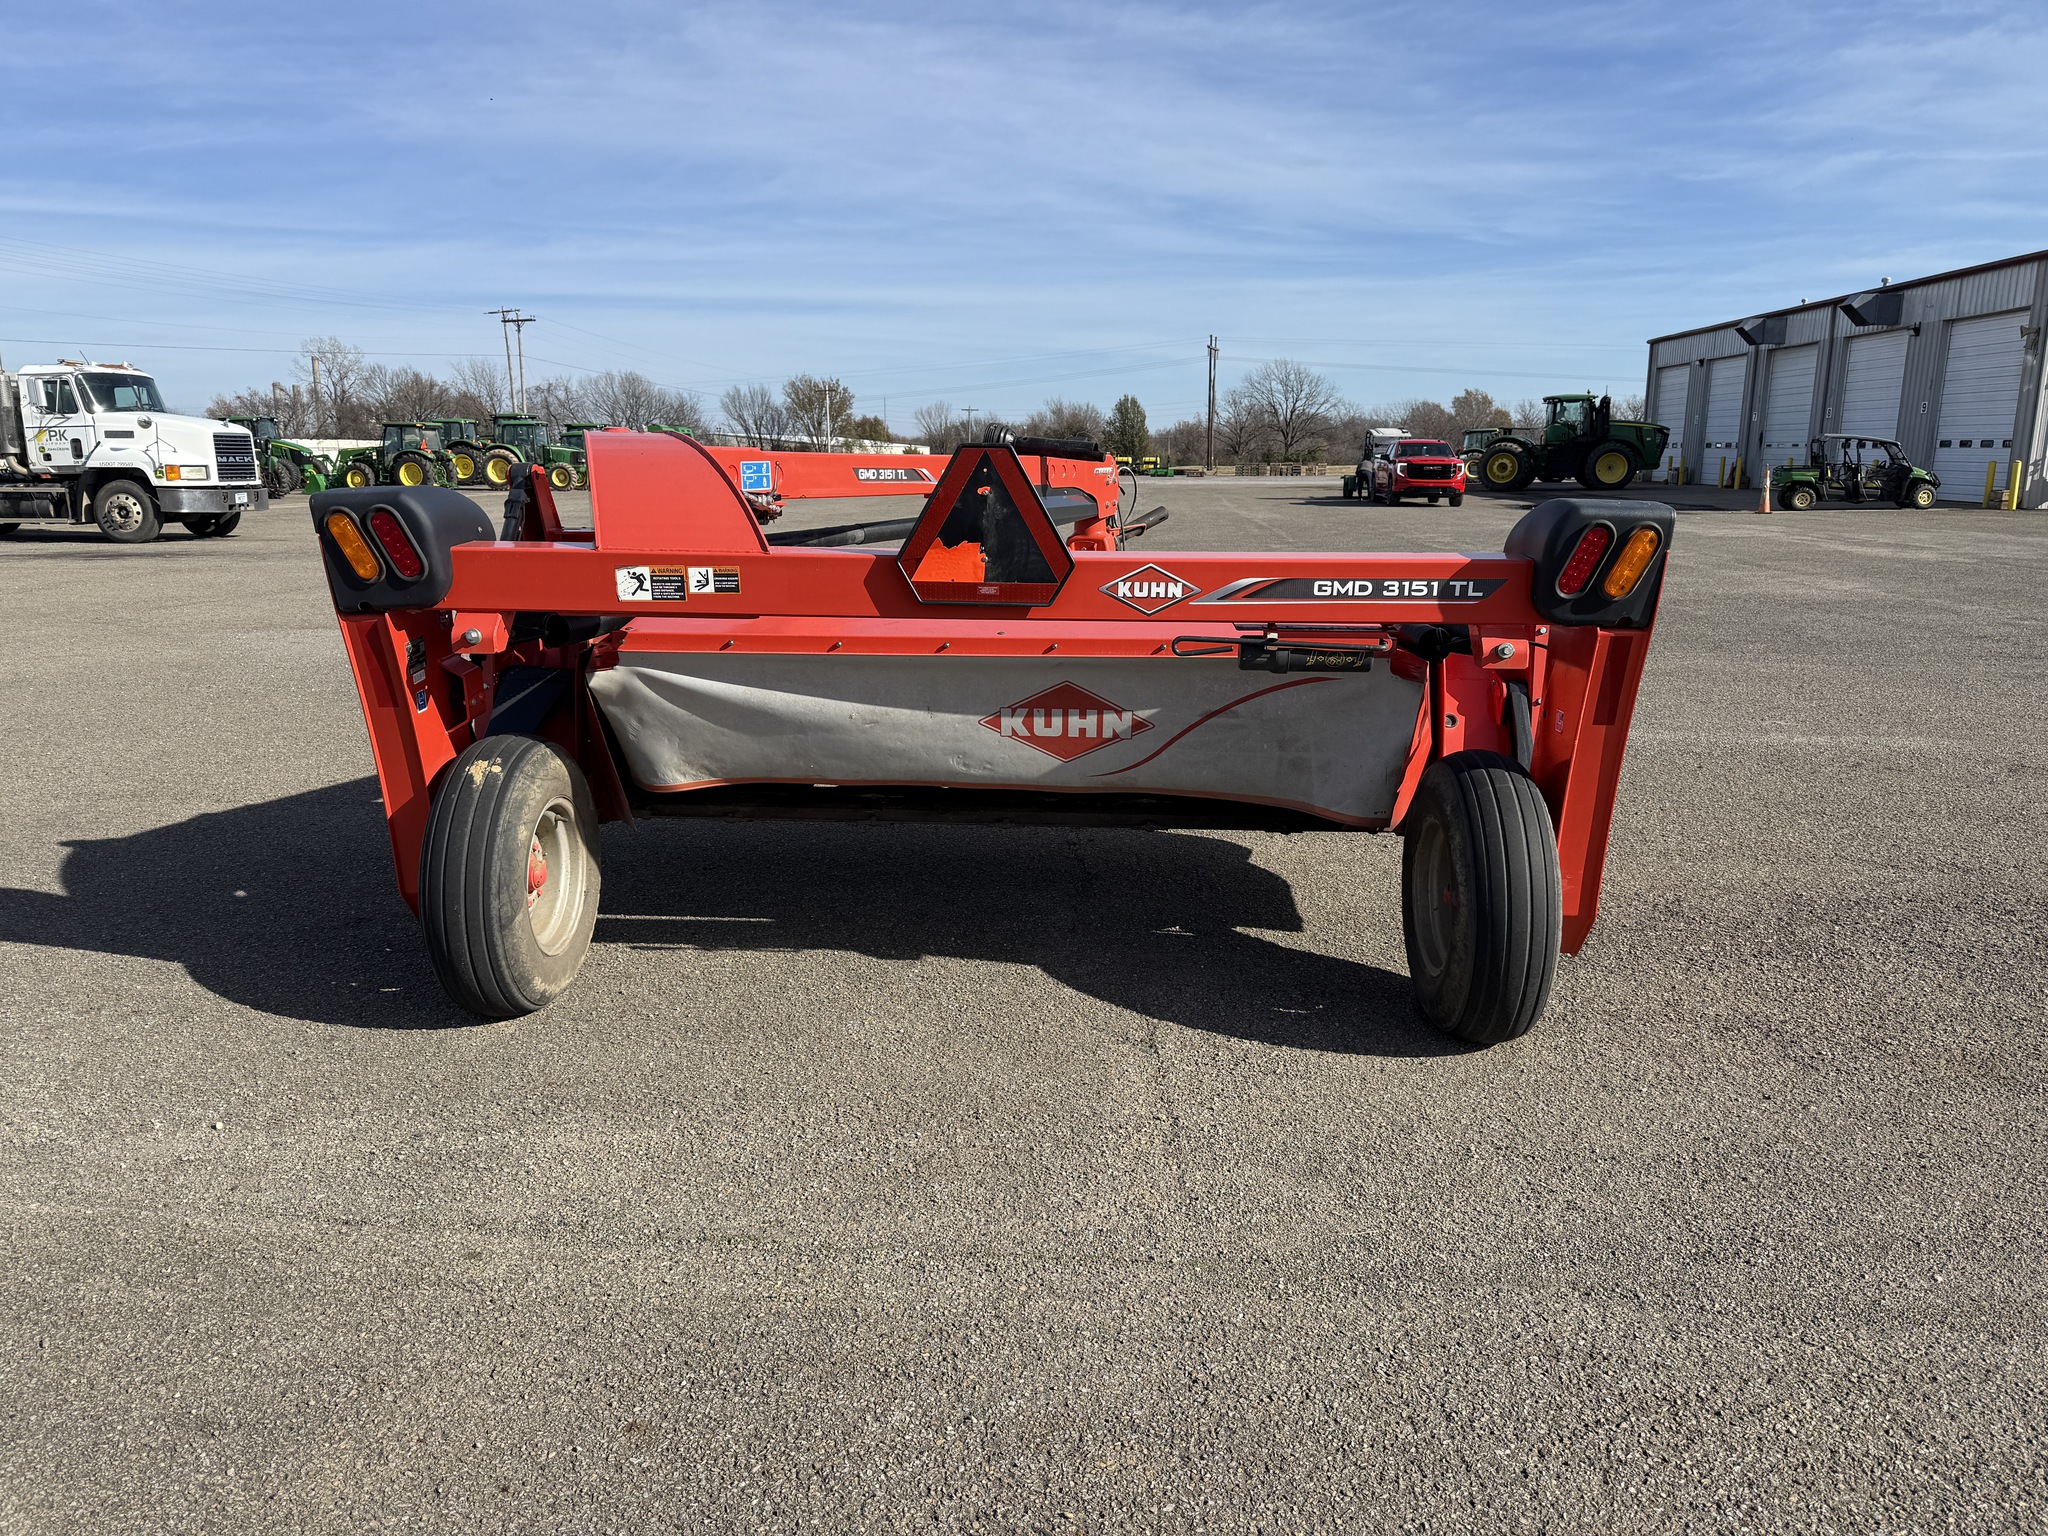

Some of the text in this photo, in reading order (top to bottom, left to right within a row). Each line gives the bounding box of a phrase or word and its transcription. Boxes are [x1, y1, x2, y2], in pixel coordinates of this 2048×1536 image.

[858, 468, 908, 480] GMD 3151 TL
[1117, 581, 1183, 599] KUHN
[1313, 580, 1484, 597] GMD 3151 TL
[1000, 707, 1133, 740] KUHN
